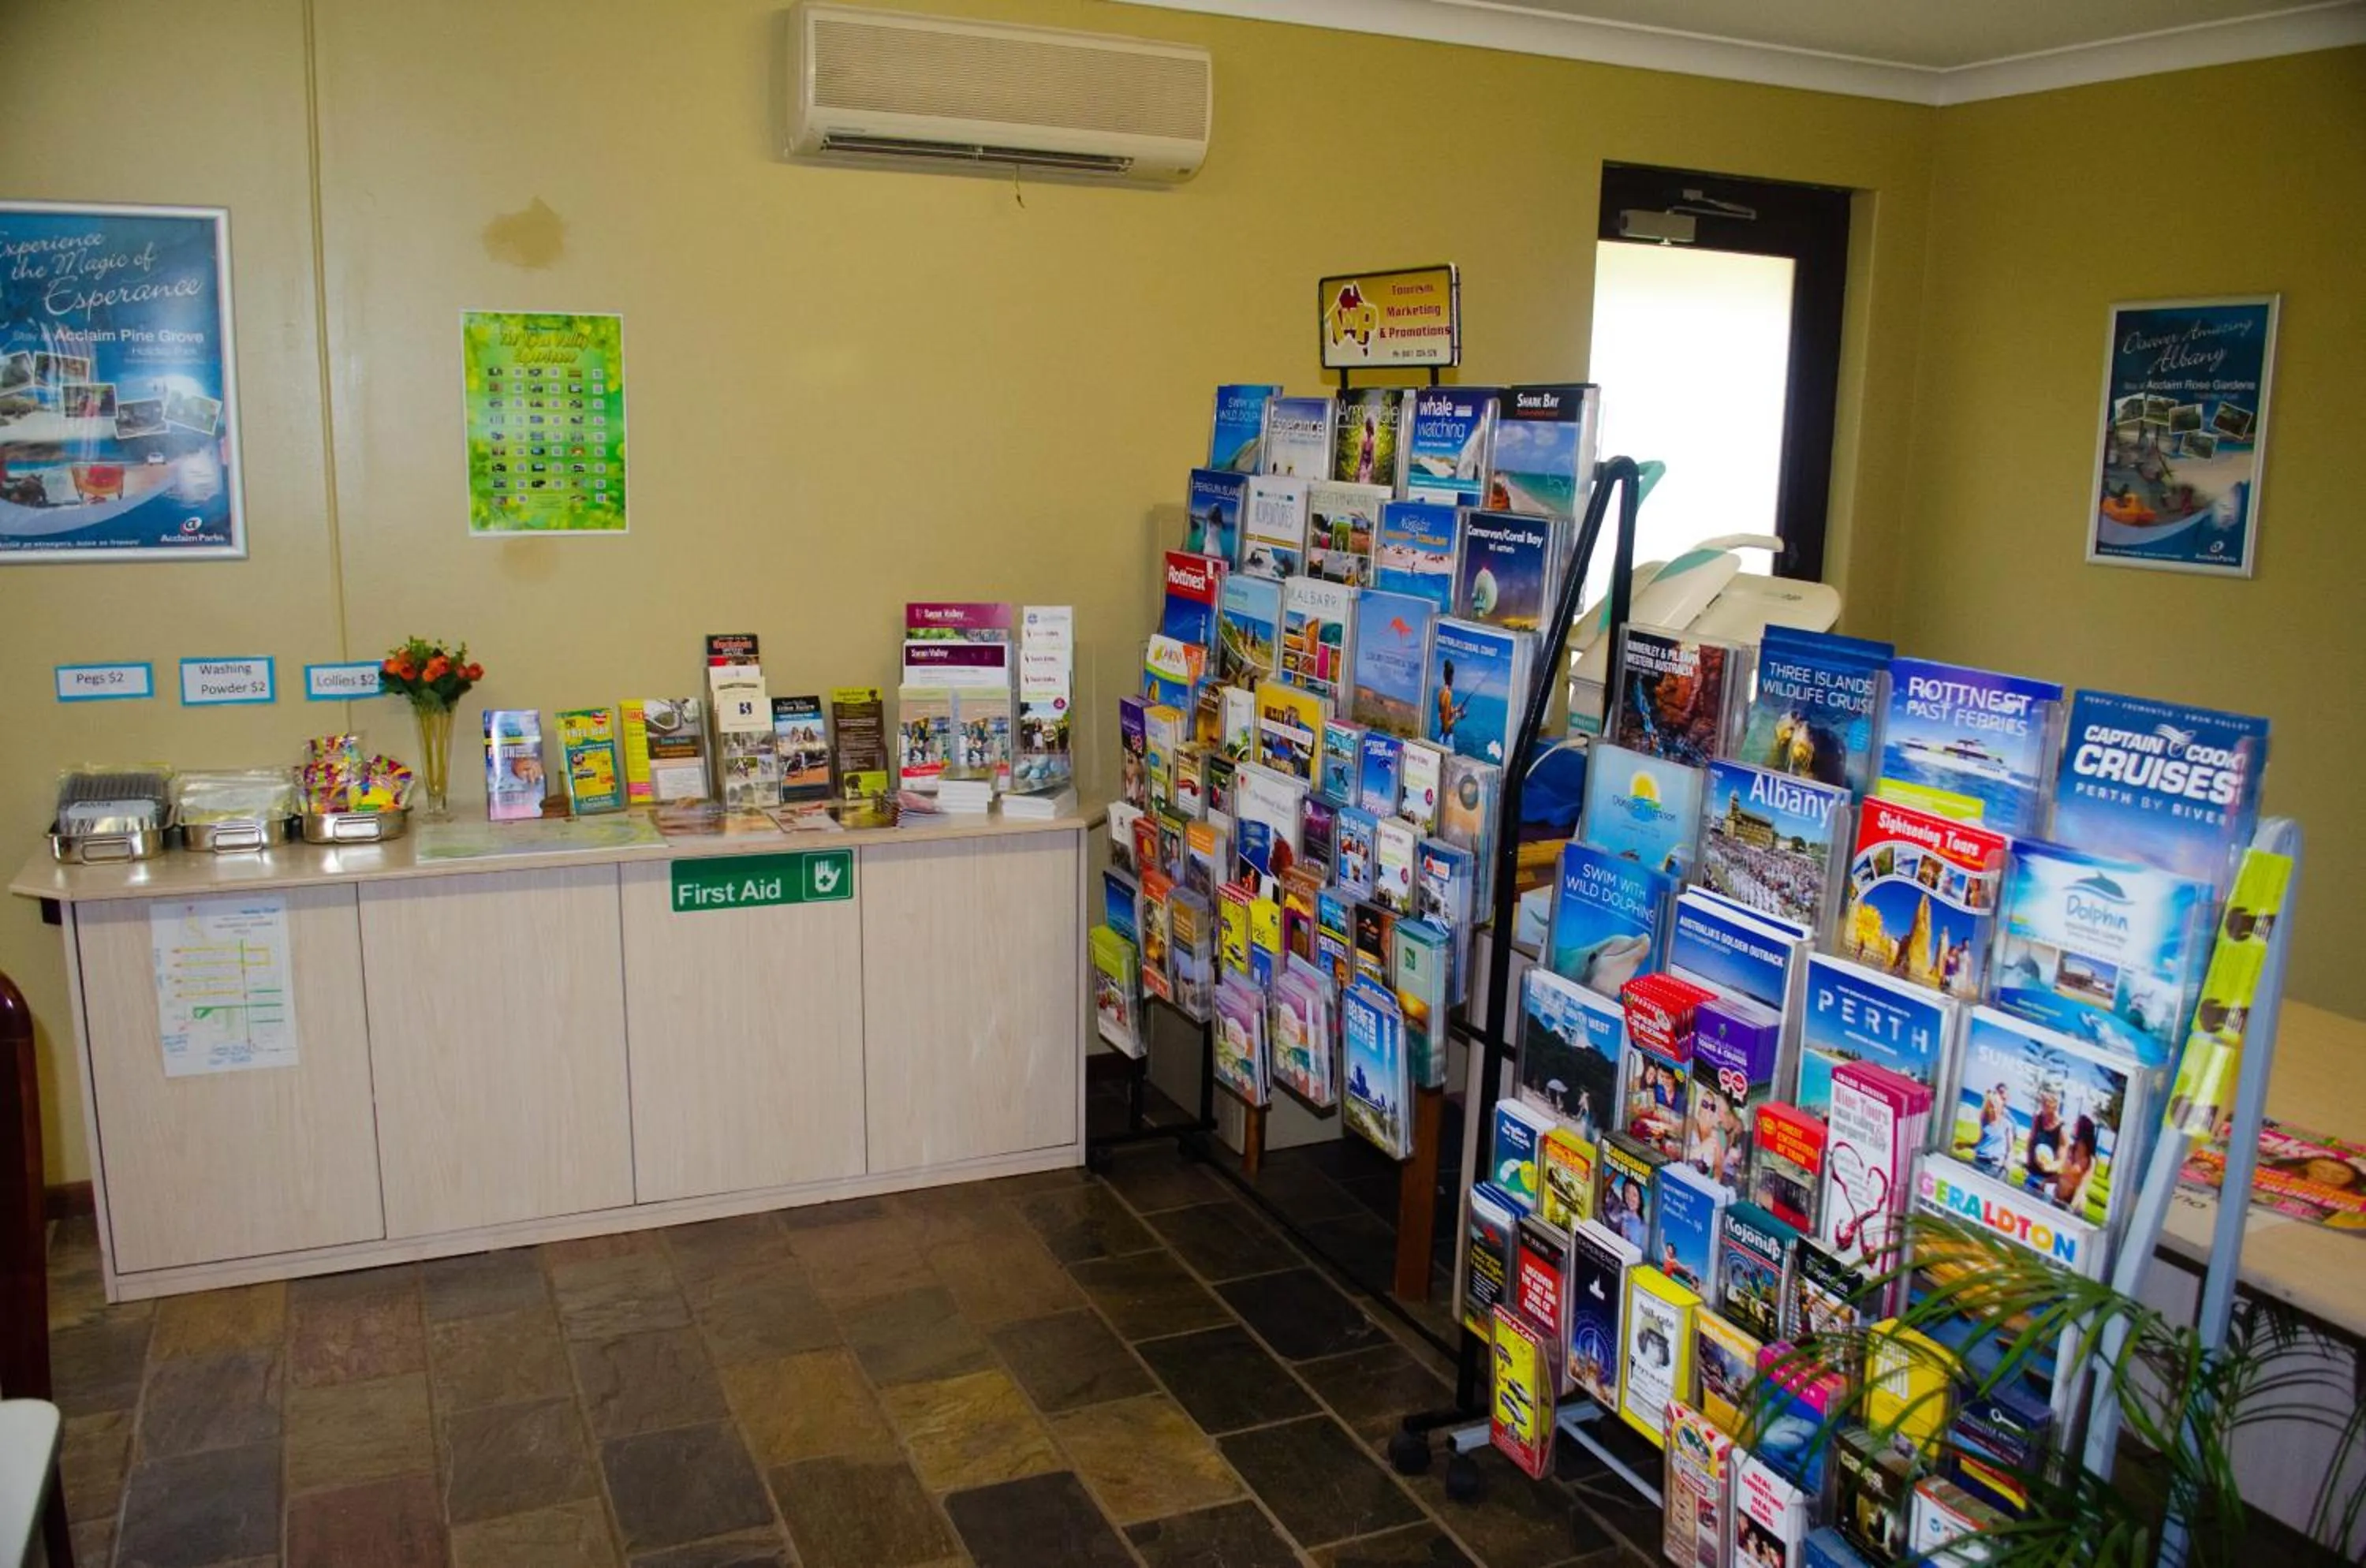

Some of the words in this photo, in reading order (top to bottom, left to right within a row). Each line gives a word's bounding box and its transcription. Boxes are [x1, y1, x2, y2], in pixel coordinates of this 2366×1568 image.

[11, 257, 47, 281] the
[54, 249, 129, 281] Magic
[132, 241, 157, 274] of
[43, 275, 203, 322] Esperance
[1391, 283, 1434, 297] Tourism
[1386, 304, 1442, 318] Marketing
[54, 328, 117, 343] Acclaim
[121, 328, 155, 343] Pine
[158, 328, 205, 344] Grove
[1380, 329, 1387, 339] &
[1389, 324, 1452, 340] Promotions
[2146, 343, 2227, 376] Albany
[2145, 379, 2182, 391] Acclaim
[2185, 379, 2211, 391] Rose
[2212, 379, 2256, 392] Gardens
[1337, 398, 1399, 424] Armale
[1419, 395, 1453, 417] whale
[1517, 393, 1542, 409] SHARK
[1543, 393, 1560, 409] BAY
[1416, 419, 1466, 444] watching
[160, 533, 197, 543] Acclaim
[1527, 530, 1544, 549] Bay
[1167, 563, 1207, 592] Rottnest
[924, 608, 942, 619] Swan
[943, 607, 964, 620] Valley
[76, 673, 106, 687] Pegs
[108, 670, 125, 685] $2
[199, 662, 252, 678] Washing
[315, 673, 358, 688] Lollies
[360, 673, 377, 687] $2
[1768, 661, 1812, 684] THREE
[1815, 670, 1874, 696] ISLANDS
[200, 681, 248, 695] Powder
[250, 679, 267, 693] $2
[1763, 678, 1824, 704] WILDLIFE
[1907, 676, 2033, 719] ROTTNEST
[1954, 709, 2028, 738] FERRIES
[2084, 724, 2166, 756] CAPTAIN
[2185, 745, 2247, 771] COOK
[2073, 743, 2244, 806] CRUISES
[1748, 773, 1834, 828] Albany
[2075, 782, 2133, 805] PERTH
[2140, 797, 2163, 810] BY
[1877, 811, 1941, 848] Sightseeing
[1945, 831, 1980, 858] Tours
[677, 882, 735, 906] First
[740, 878, 782, 902] Aid
[1582, 863, 1617, 888] SWIM
[1620, 875, 1648, 902] WITH
[1566, 874, 1599, 898] WILD
[1601, 889, 1656, 925] DOLPHINS
[2066, 894, 2129, 931] Dolphin
[1679, 915, 1721, 942] AUSTRALIA'S
[1721, 932, 1749, 954] GOLDEN
[1749, 945, 1785, 969] OUTBACK
[1817, 987, 1930, 1055] PERTH
[1917, 1170, 2076, 1264] GERALDTON
[1724, 1215, 1782, 1261] Kojonup
[1751, 1471, 1772, 1491] REAL
[1751, 1495, 1771, 1515] REAL
